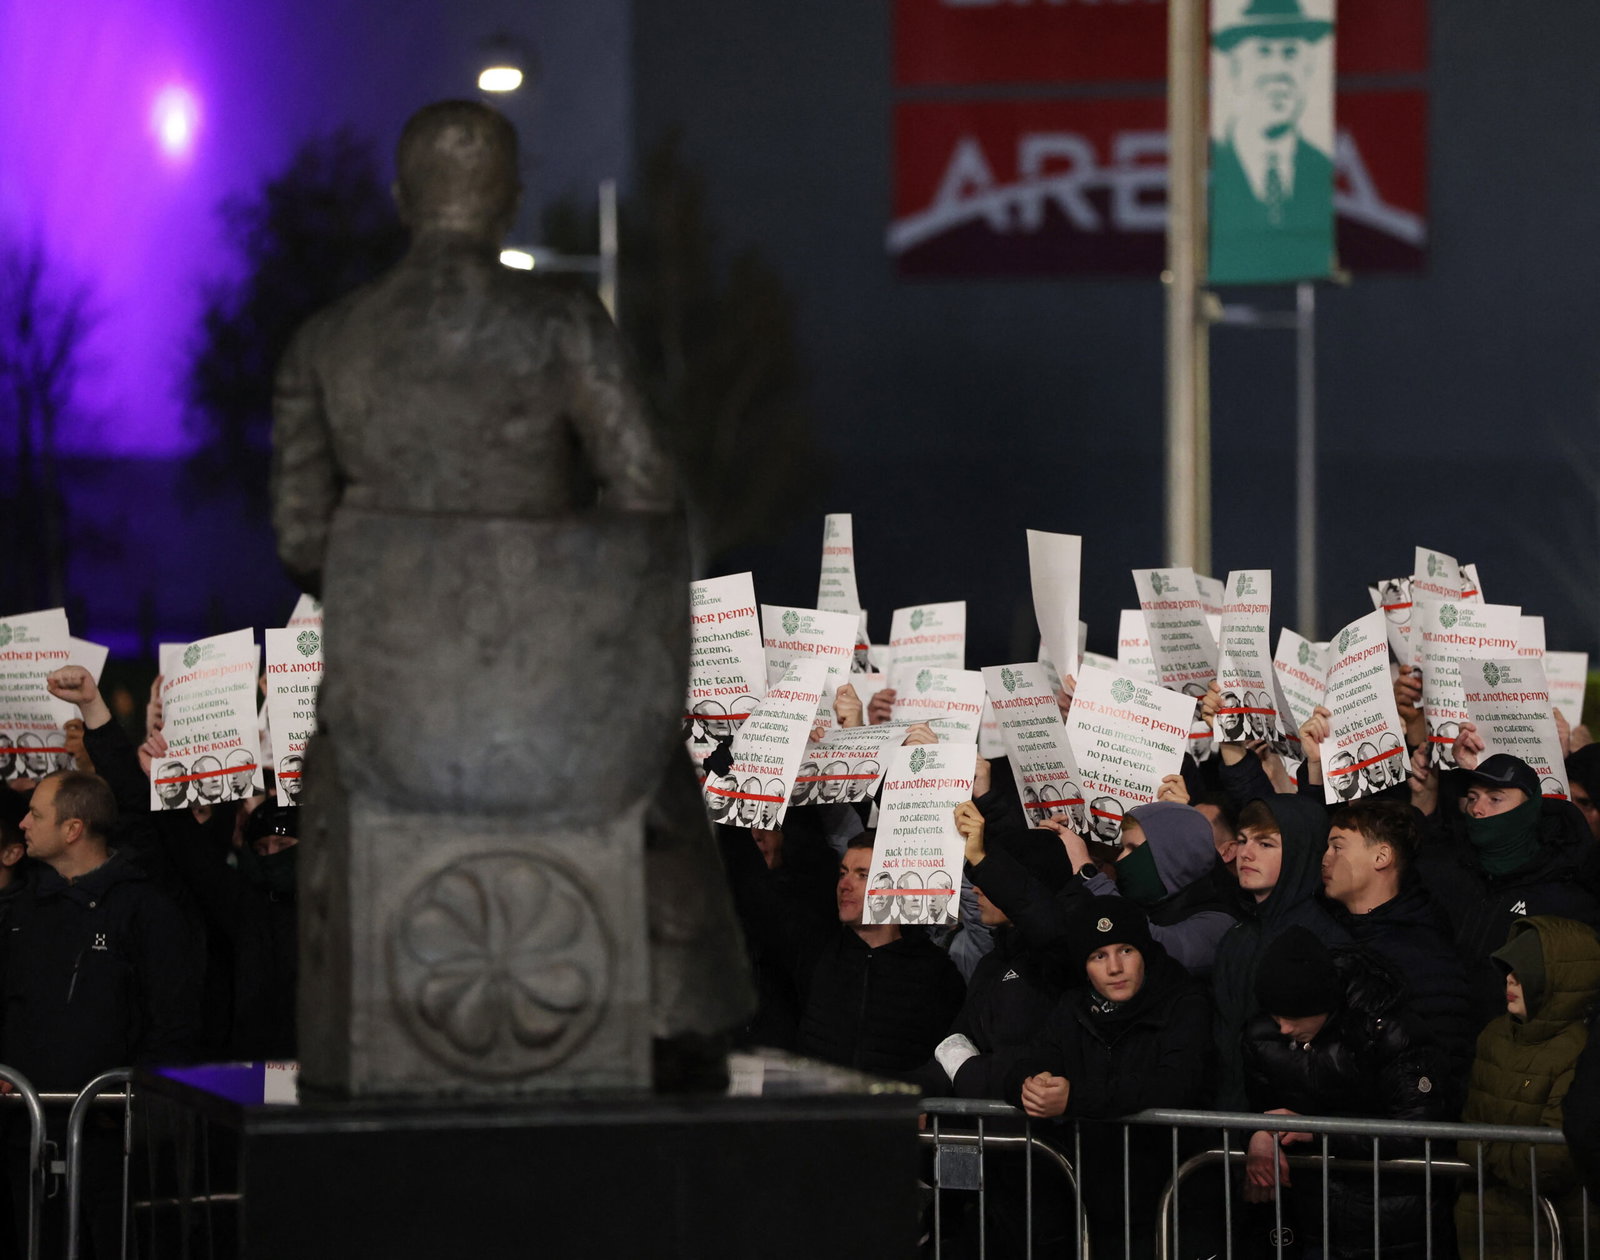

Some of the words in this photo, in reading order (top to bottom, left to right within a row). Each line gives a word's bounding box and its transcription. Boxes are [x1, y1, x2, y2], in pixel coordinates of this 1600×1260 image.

[886, 130, 1428, 252] AREA
[718, 606, 755, 623] penny
[1433, 633, 1476, 645] another
[1479, 637, 1518, 650] penny
[764, 639, 777, 648] not
[779, 640, 814, 652] another
[816, 645, 853, 657] penny
[1518, 648, 1544, 658] enny
[0, 651, 32, 660] other
[35, 650, 70, 662] penny
[706, 656, 741, 666] events.
[1333, 651, 1363, 675] another
[1363, 642, 1387, 662] penny
[268, 663, 288, 673] not
[290, 661, 325, 672] anoth
[176, 668, 219, 686] another
[221, 661, 254, 676] penny
[693, 677, 712, 687] the
[715, 675, 746, 685] team.
[1431, 679, 1439, 687] no
[1440, 678, 1457, 688] paid
[277, 686, 289, 694] no
[290, 684, 309, 693] club
[693, 688, 712, 698] the
[791, 691, 820, 704] penny
[992, 699, 1004, 710] not
[1004, 696, 1034, 709] another
[1034, 695, 1056, 708] penny
[1336, 693, 1345, 702] no
[1443, 698, 1460, 708] the
[1466, 694, 1480, 702] not
[1483, 691, 1519, 702] another
[1520, 691, 1549, 703] penny
[179, 705, 190, 713] no
[908, 699, 945, 709] another
[947, 701, 982, 714] penny
[1134, 699, 1162, 712] collective
[1333, 707, 1342, 716] no
[1342, 701, 1357, 714] paid
[293, 711, 304, 719] no
[1073, 698, 1096, 711] not
[1097, 705, 1150, 726] another
[1150, 719, 1189, 740] penny
[1441, 709, 1458, 718] the
[1485, 713, 1500, 721] club
[1501, 712, 1549, 720] merchandise.
[173, 718, 185, 727] no
[186, 713, 205, 726] paid
[750, 721, 759, 729] no
[1335, 724, 1351, 738] back
[1351, 719, 1363, 731] the
[169, 736, 191, 748] back
[193, 732, 211, 744] the
[288, 731, 310, 740] back
[1077, 721, 1091, 731] no
[1092, 725, 1114, 736] club
[1114, 731, 1177, 756] merchandise.
[1337, 736, 1354, 749] sack
[1353, 730, 1365, 741] the
[1502, 736, 1517, 746] paid
[1096, 739, 1110, 748] no
[168, 748, 191, 758] sack
[193, 743, 211, 754] the
[809, 751, 828, 759] sack
[1087, 749, 1100, 759] no
[1101, 753, 1122, 765] paid
[1525, 756, 1549, 765] team.
[748, 763, 759, 772] the
[1033, 761, 1045, 771] the
[1036, 772, 1048, 782] the
[884, 780, 899, 790] not
[901, 778, 936, 789] another
[937, 779, 972, 791] penny
[1103, 773, 1121, 785] the
[1124, 780, 1154, 794] team.
[1098, 783, 1118, 795] the
[1119, 789, 1154, 804] board
[887, 803, 897, 811] no
[897, 801, 911, 810] club
[900, 814, 909, 822] no
[893, 827, 902, 835] no
[902, 826, 918, 836] paid
[918, 826, 944, 835] events.
[885, 847, 902, 857] back
[904, 846, 918, 857] the
[920, 846, 944, 857] team.
[883, 858, 899, 868] sack
[902, 857, 917, 868] the
